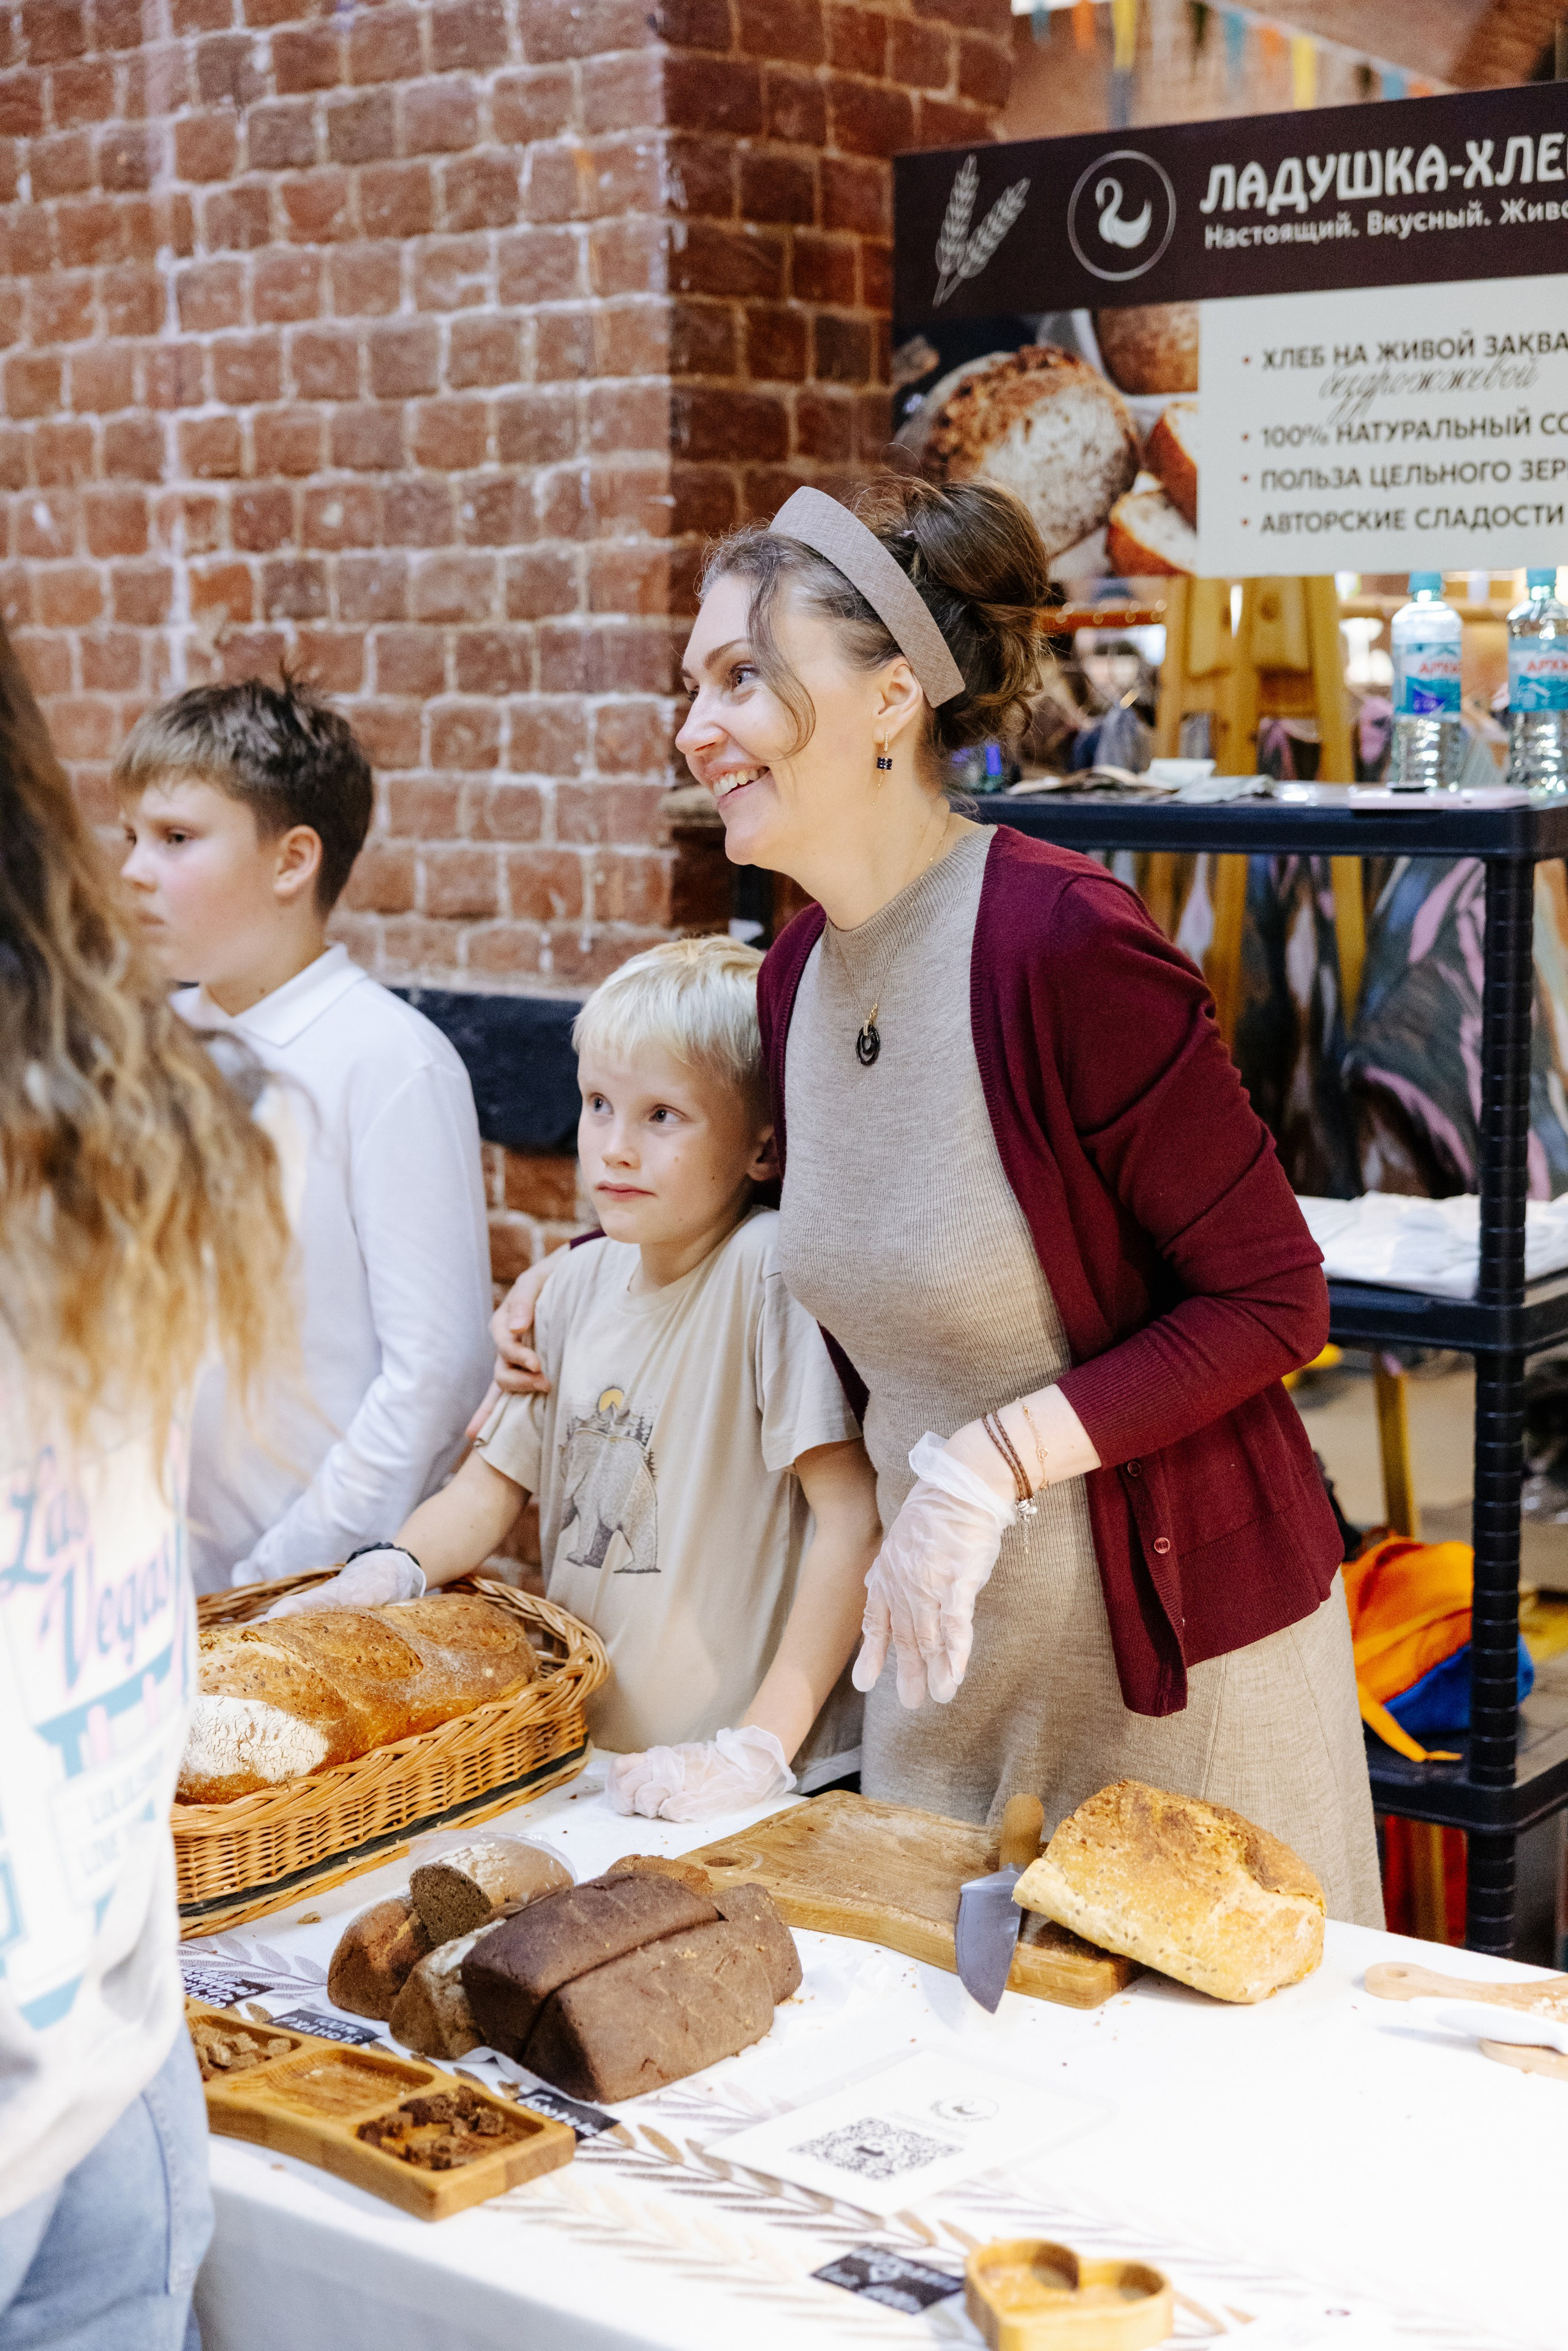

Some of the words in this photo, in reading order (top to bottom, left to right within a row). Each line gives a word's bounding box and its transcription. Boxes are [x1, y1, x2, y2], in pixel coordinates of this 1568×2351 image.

[1199, 132, 1568, 216] ЛАДУШКА-ХЛЕ
[1204, 212, 1360, 249] Настоящий.
[1366, 200, 1491, 240] Вкусный.
[1262, 344, 1325, 371] ХЛЕБ
[1333, 344, 1368, 368] НА
[1376, 329, 1475, 364] ЖИВОЙ
[1262, 425, 1329, 448] 100%
[1336, 406, 1531, 444] НАТУРАЛЬНЫЙ
[1261, 466, 1362, 492] ПОЛЬЗА
[1370, 459, 1512, 492] ЦЕЛЬНОГО
[1261, 508, 1406, 534] АВТОРСКИЕ
[1414, 504, 1564, 532] СЛАДОСТИ
[38, 1528, 172, 1693] Vegas
